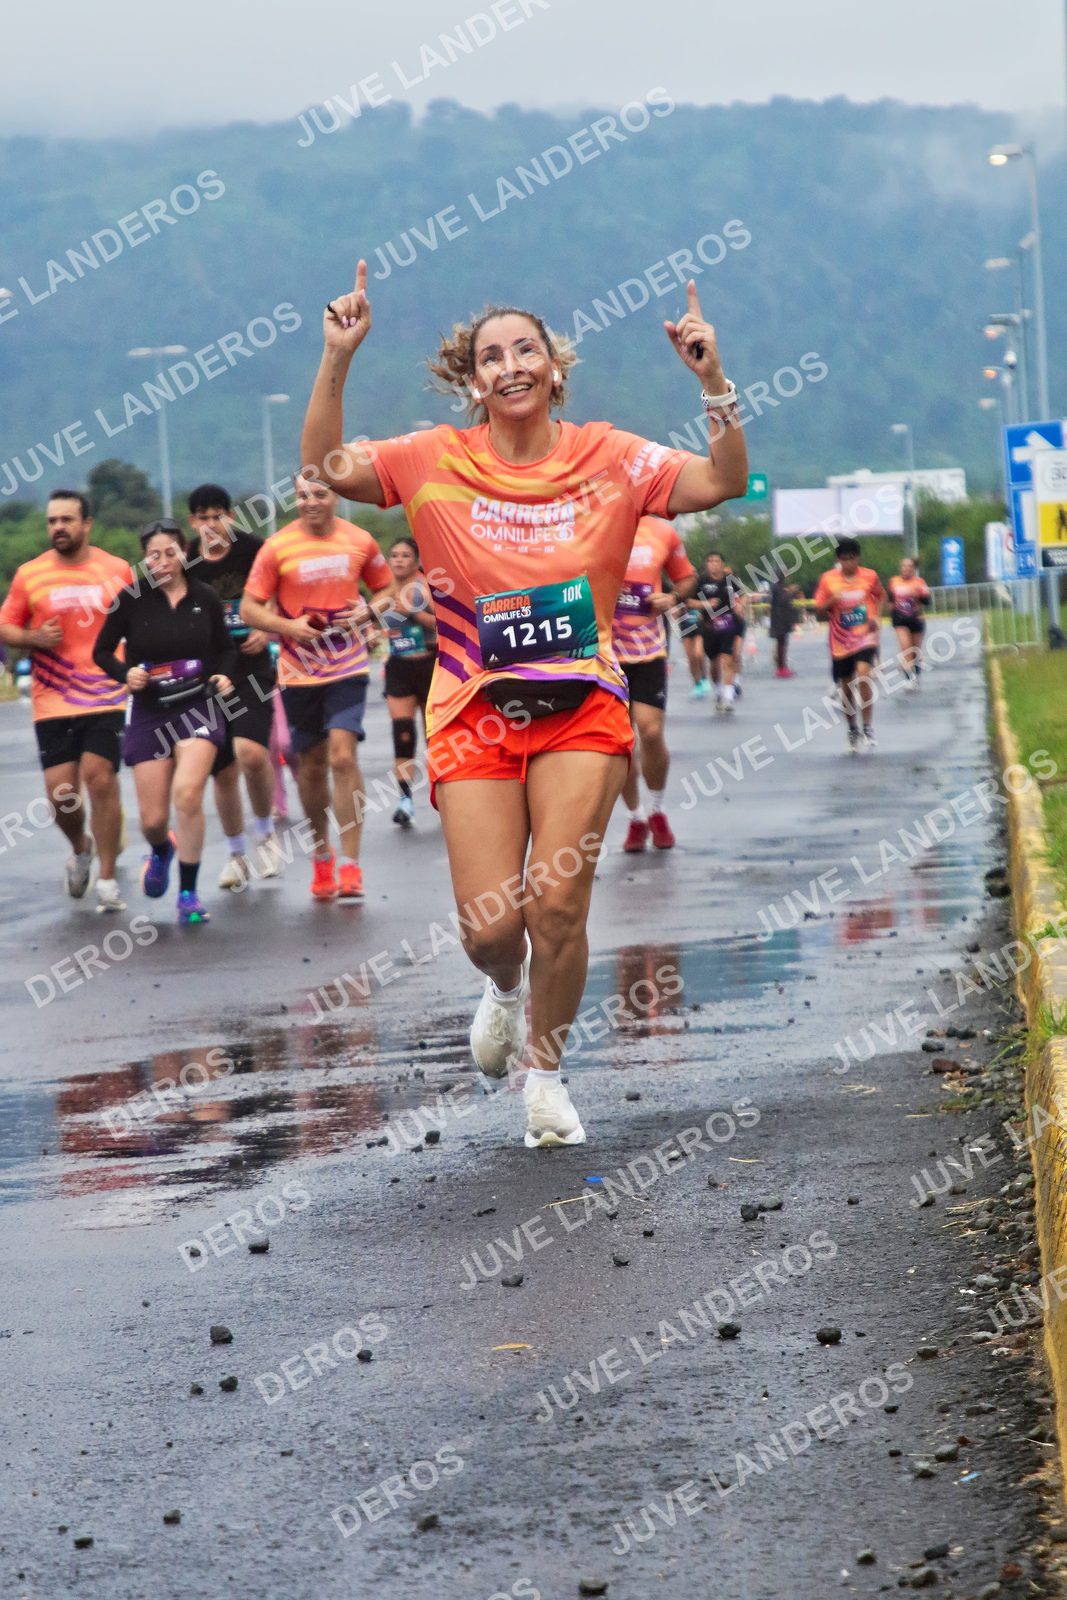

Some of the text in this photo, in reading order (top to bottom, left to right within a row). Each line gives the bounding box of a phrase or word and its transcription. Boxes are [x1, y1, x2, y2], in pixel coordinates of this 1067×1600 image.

[562, 583, 582, 604] 10K
[482, 595, 531, 615] CARRERA
[502, 615, 573, 648] 1215
